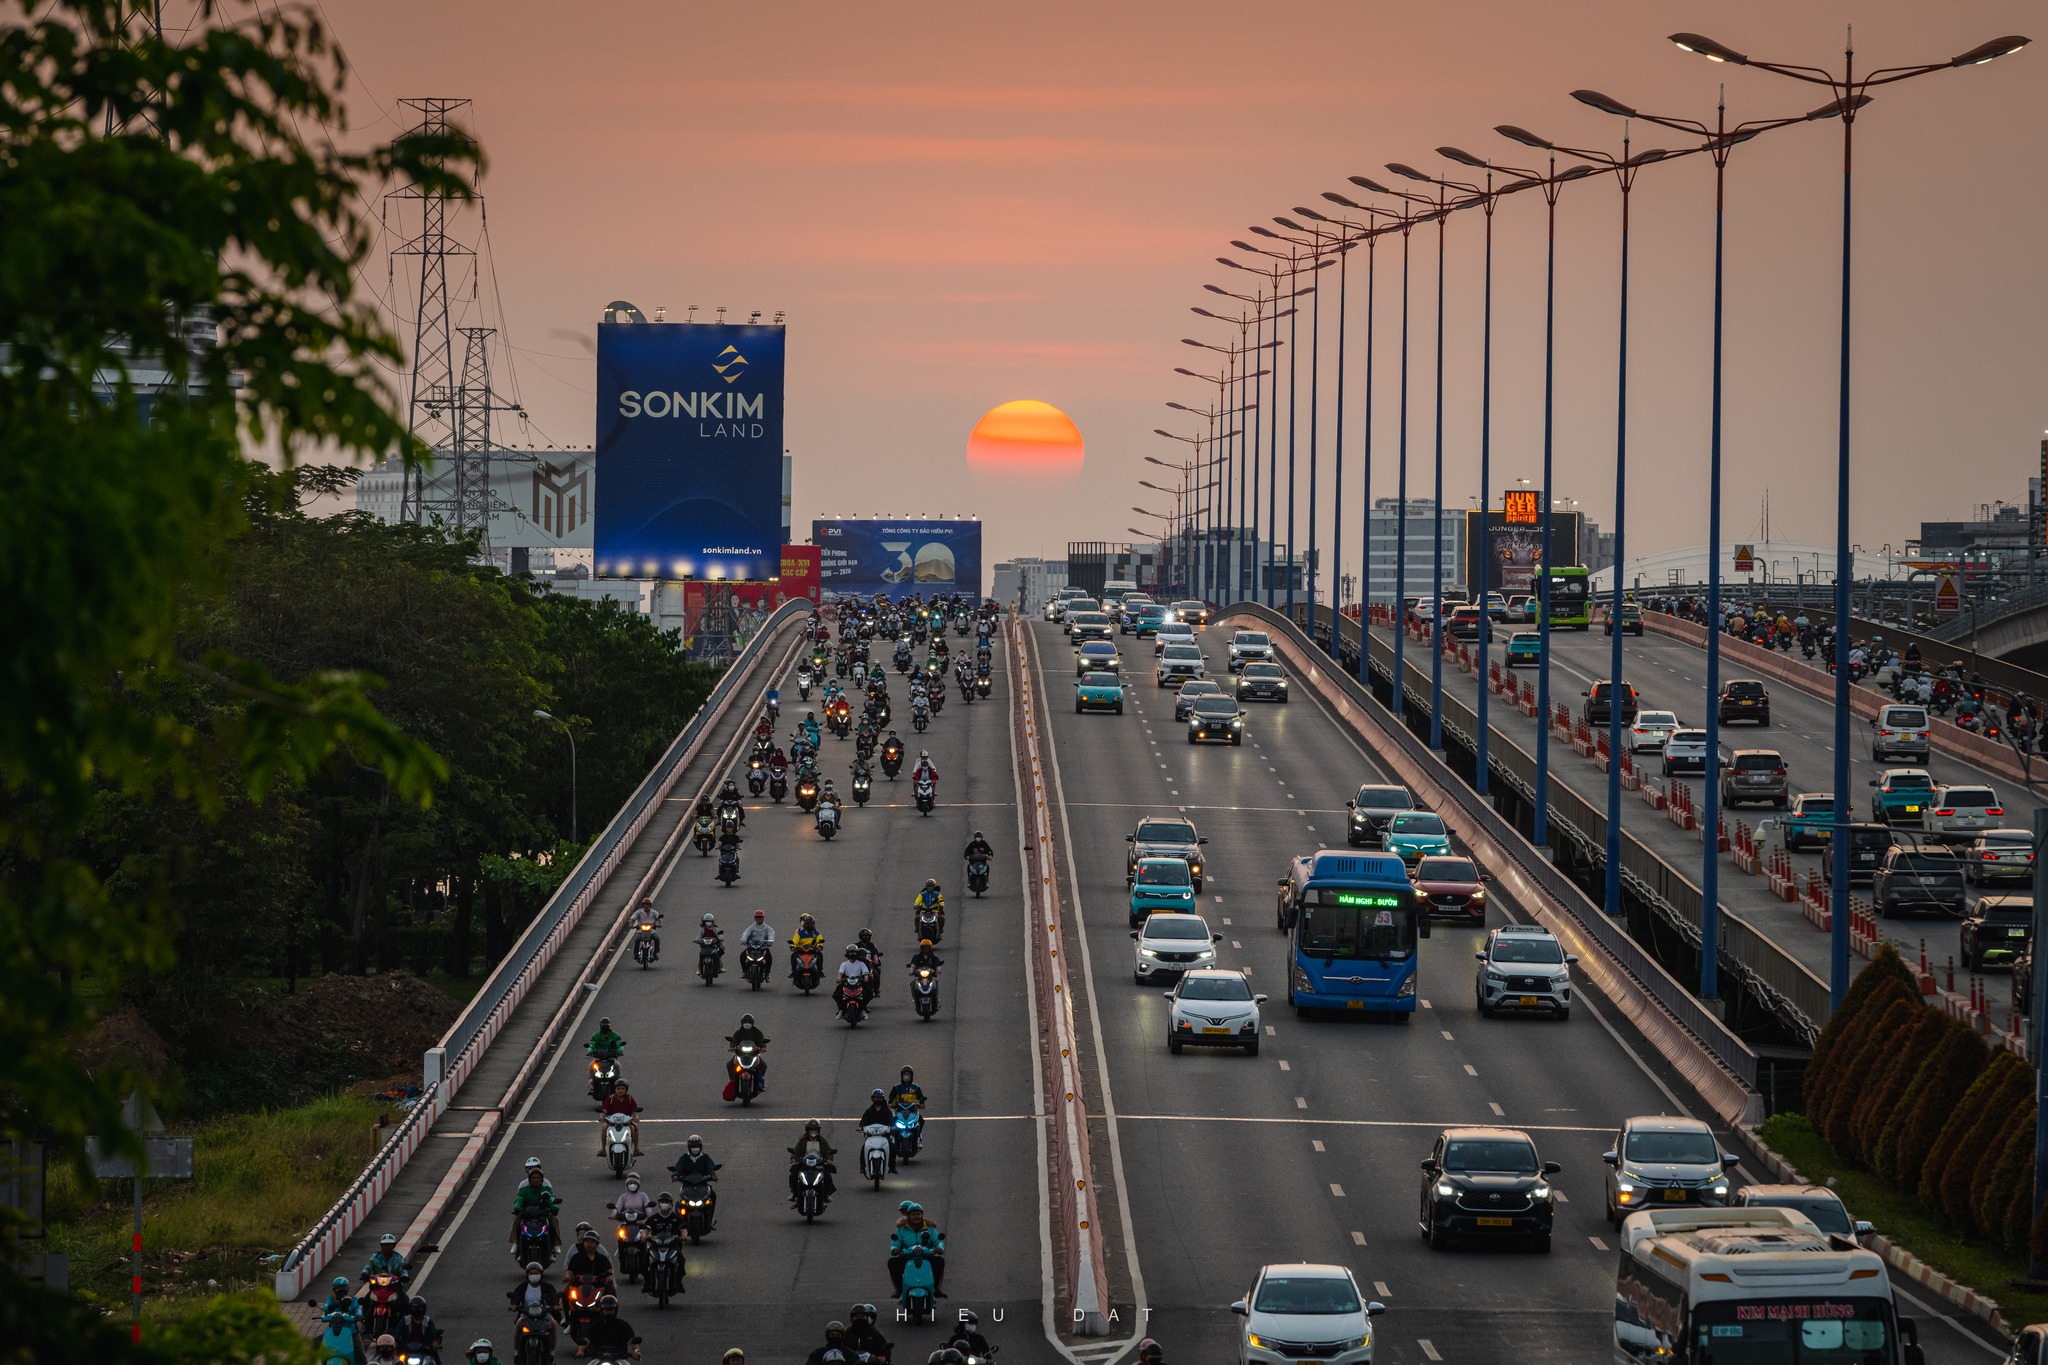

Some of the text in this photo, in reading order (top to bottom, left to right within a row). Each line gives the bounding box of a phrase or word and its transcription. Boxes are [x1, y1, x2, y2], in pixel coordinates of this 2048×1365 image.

[619, 390, 764, 420] SONKIM
[700, 422, 764, 438] LAND
[1506, 492, 1535, 502] JUN
[1506, 502, 1536, 512] GER
[702, 546, 762, 555] sonkimland.vn
[1377, 912, 1390, 924] 53
[1737, 1305, 1765, 1319] KIM
[1768, 1305, 1811, 1322] MẠNH
